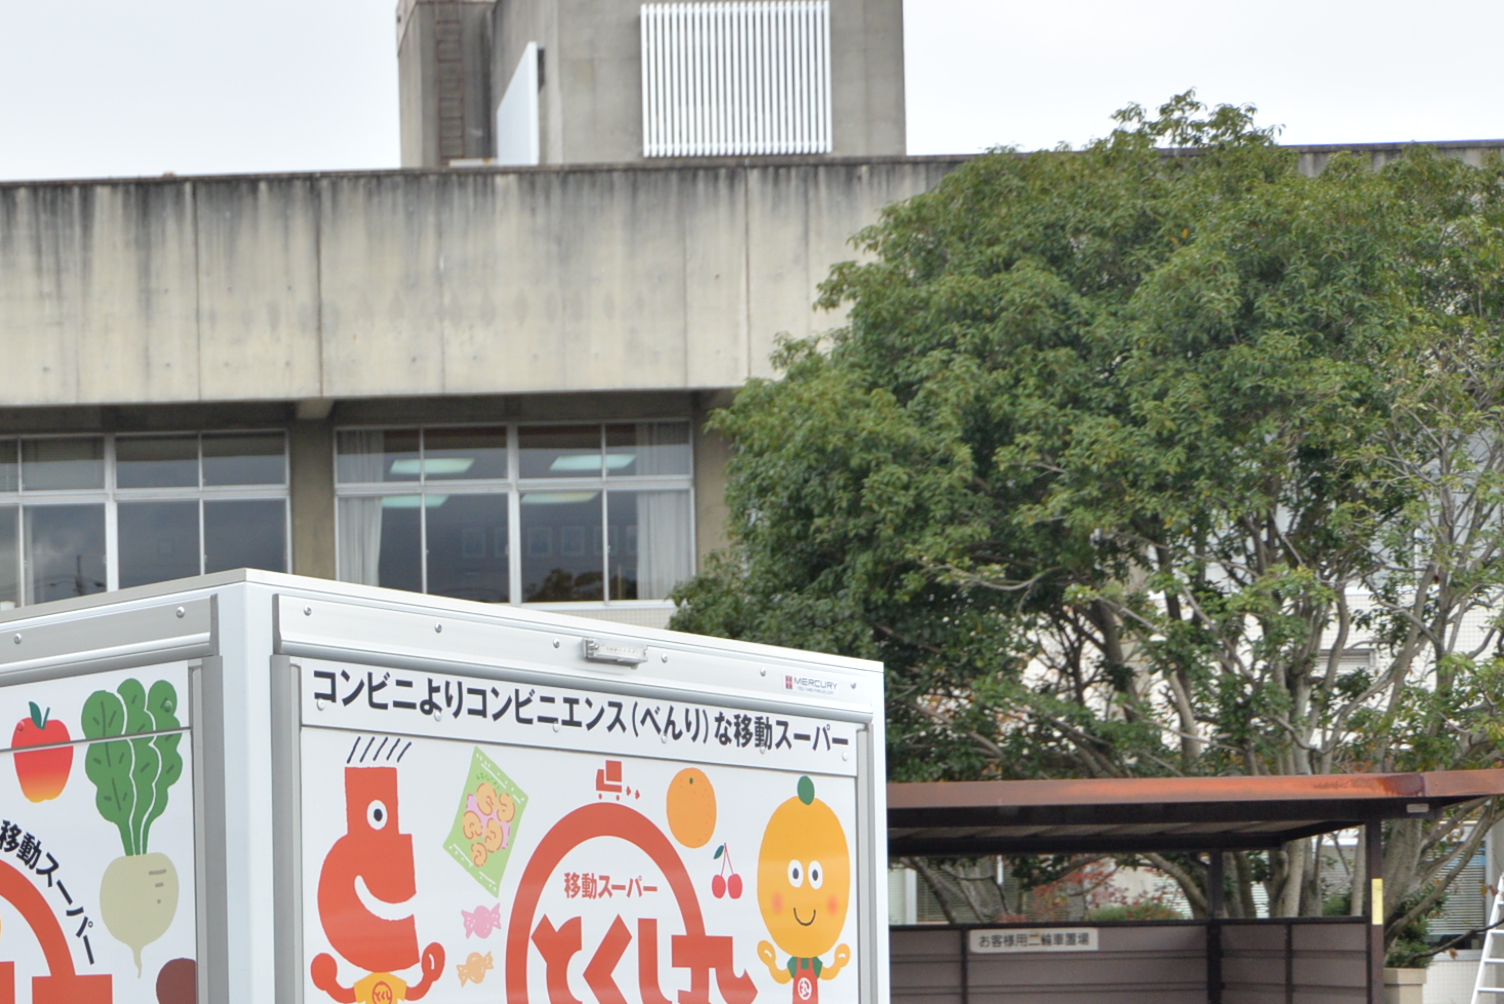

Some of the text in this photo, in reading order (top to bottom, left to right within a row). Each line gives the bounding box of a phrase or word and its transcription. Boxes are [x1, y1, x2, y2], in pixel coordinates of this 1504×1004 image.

[794, 677, 837, 690] MERCURY
[563, 872, 659, 899] 移動スーパー
[978, 932, 1089, 948] お客様用二輪車置場
